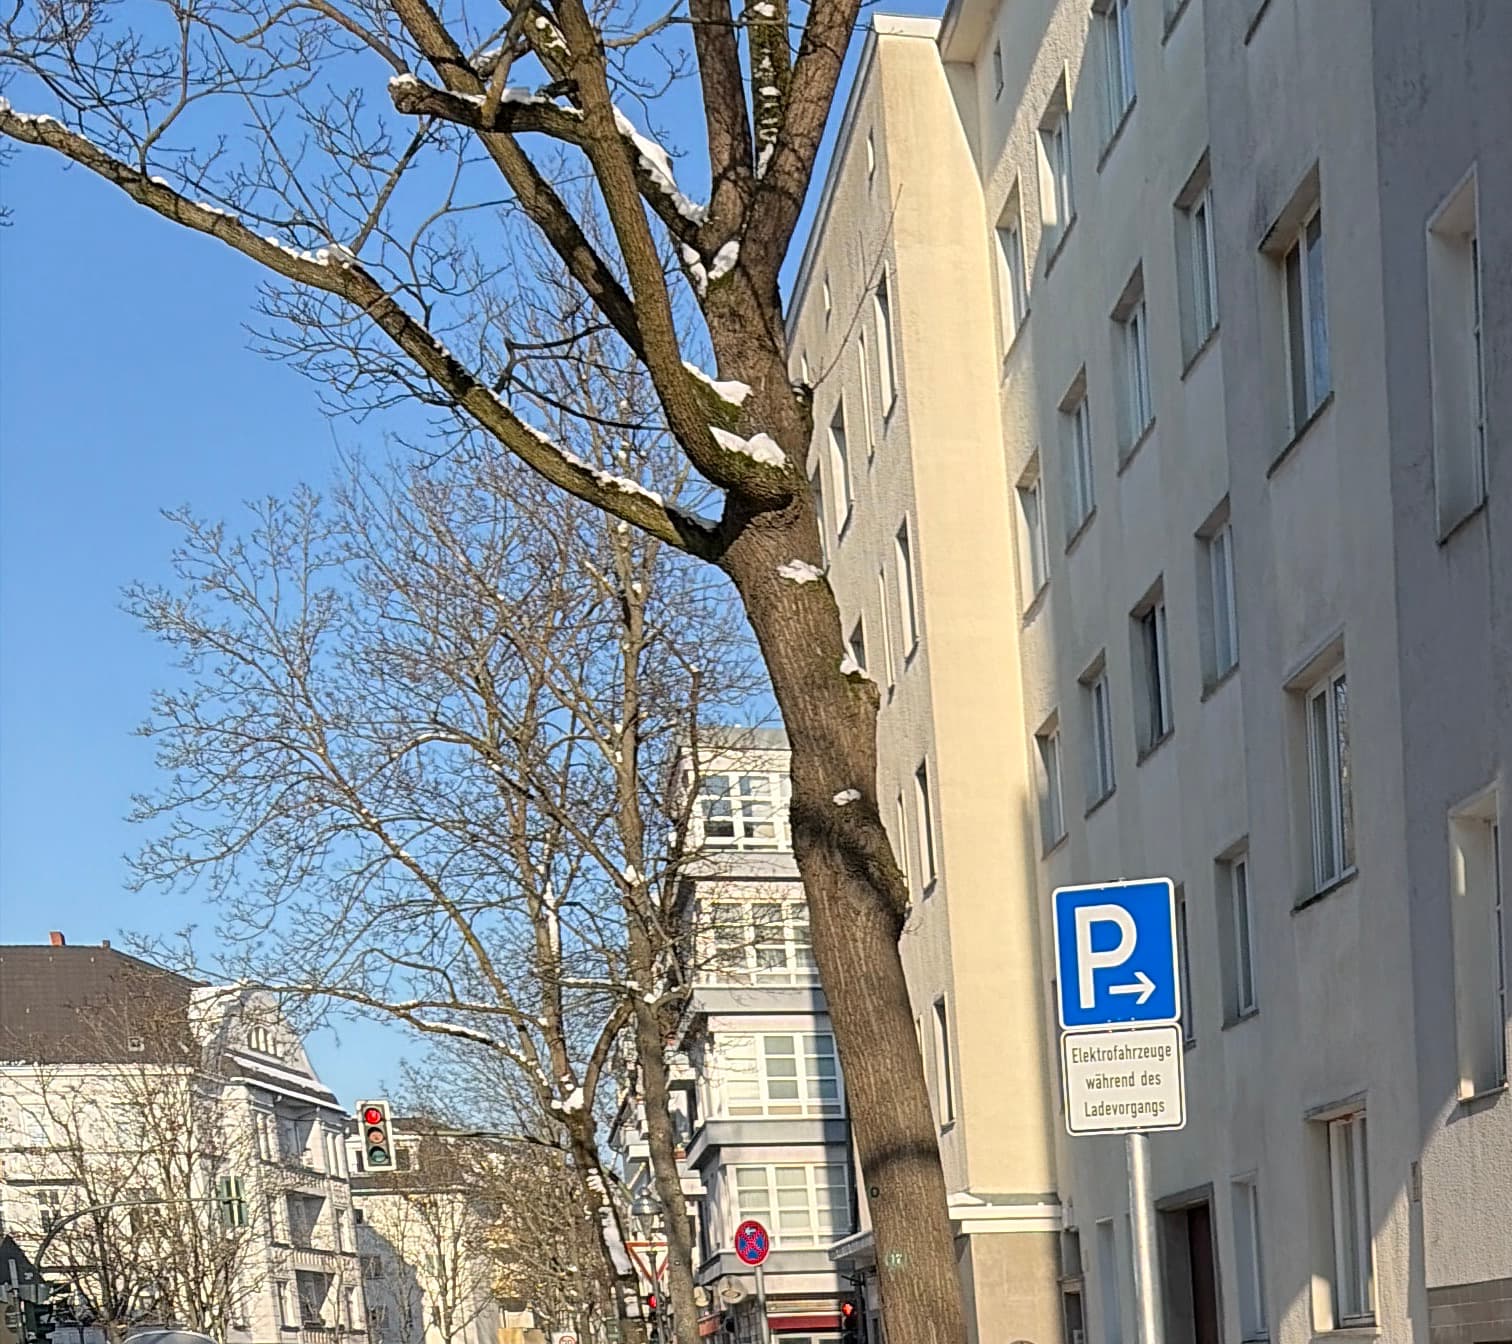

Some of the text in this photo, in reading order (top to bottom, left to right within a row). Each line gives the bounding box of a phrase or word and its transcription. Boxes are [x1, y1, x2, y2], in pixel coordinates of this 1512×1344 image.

[1074, 903, 1138, 1009] P
[1071, 1044, 1173, 1064] Elektrofahrzeuge
[1085, 1070, 1162, 1090] während des
[1084, 1100, 1166, 1119] Ladevorgangs
